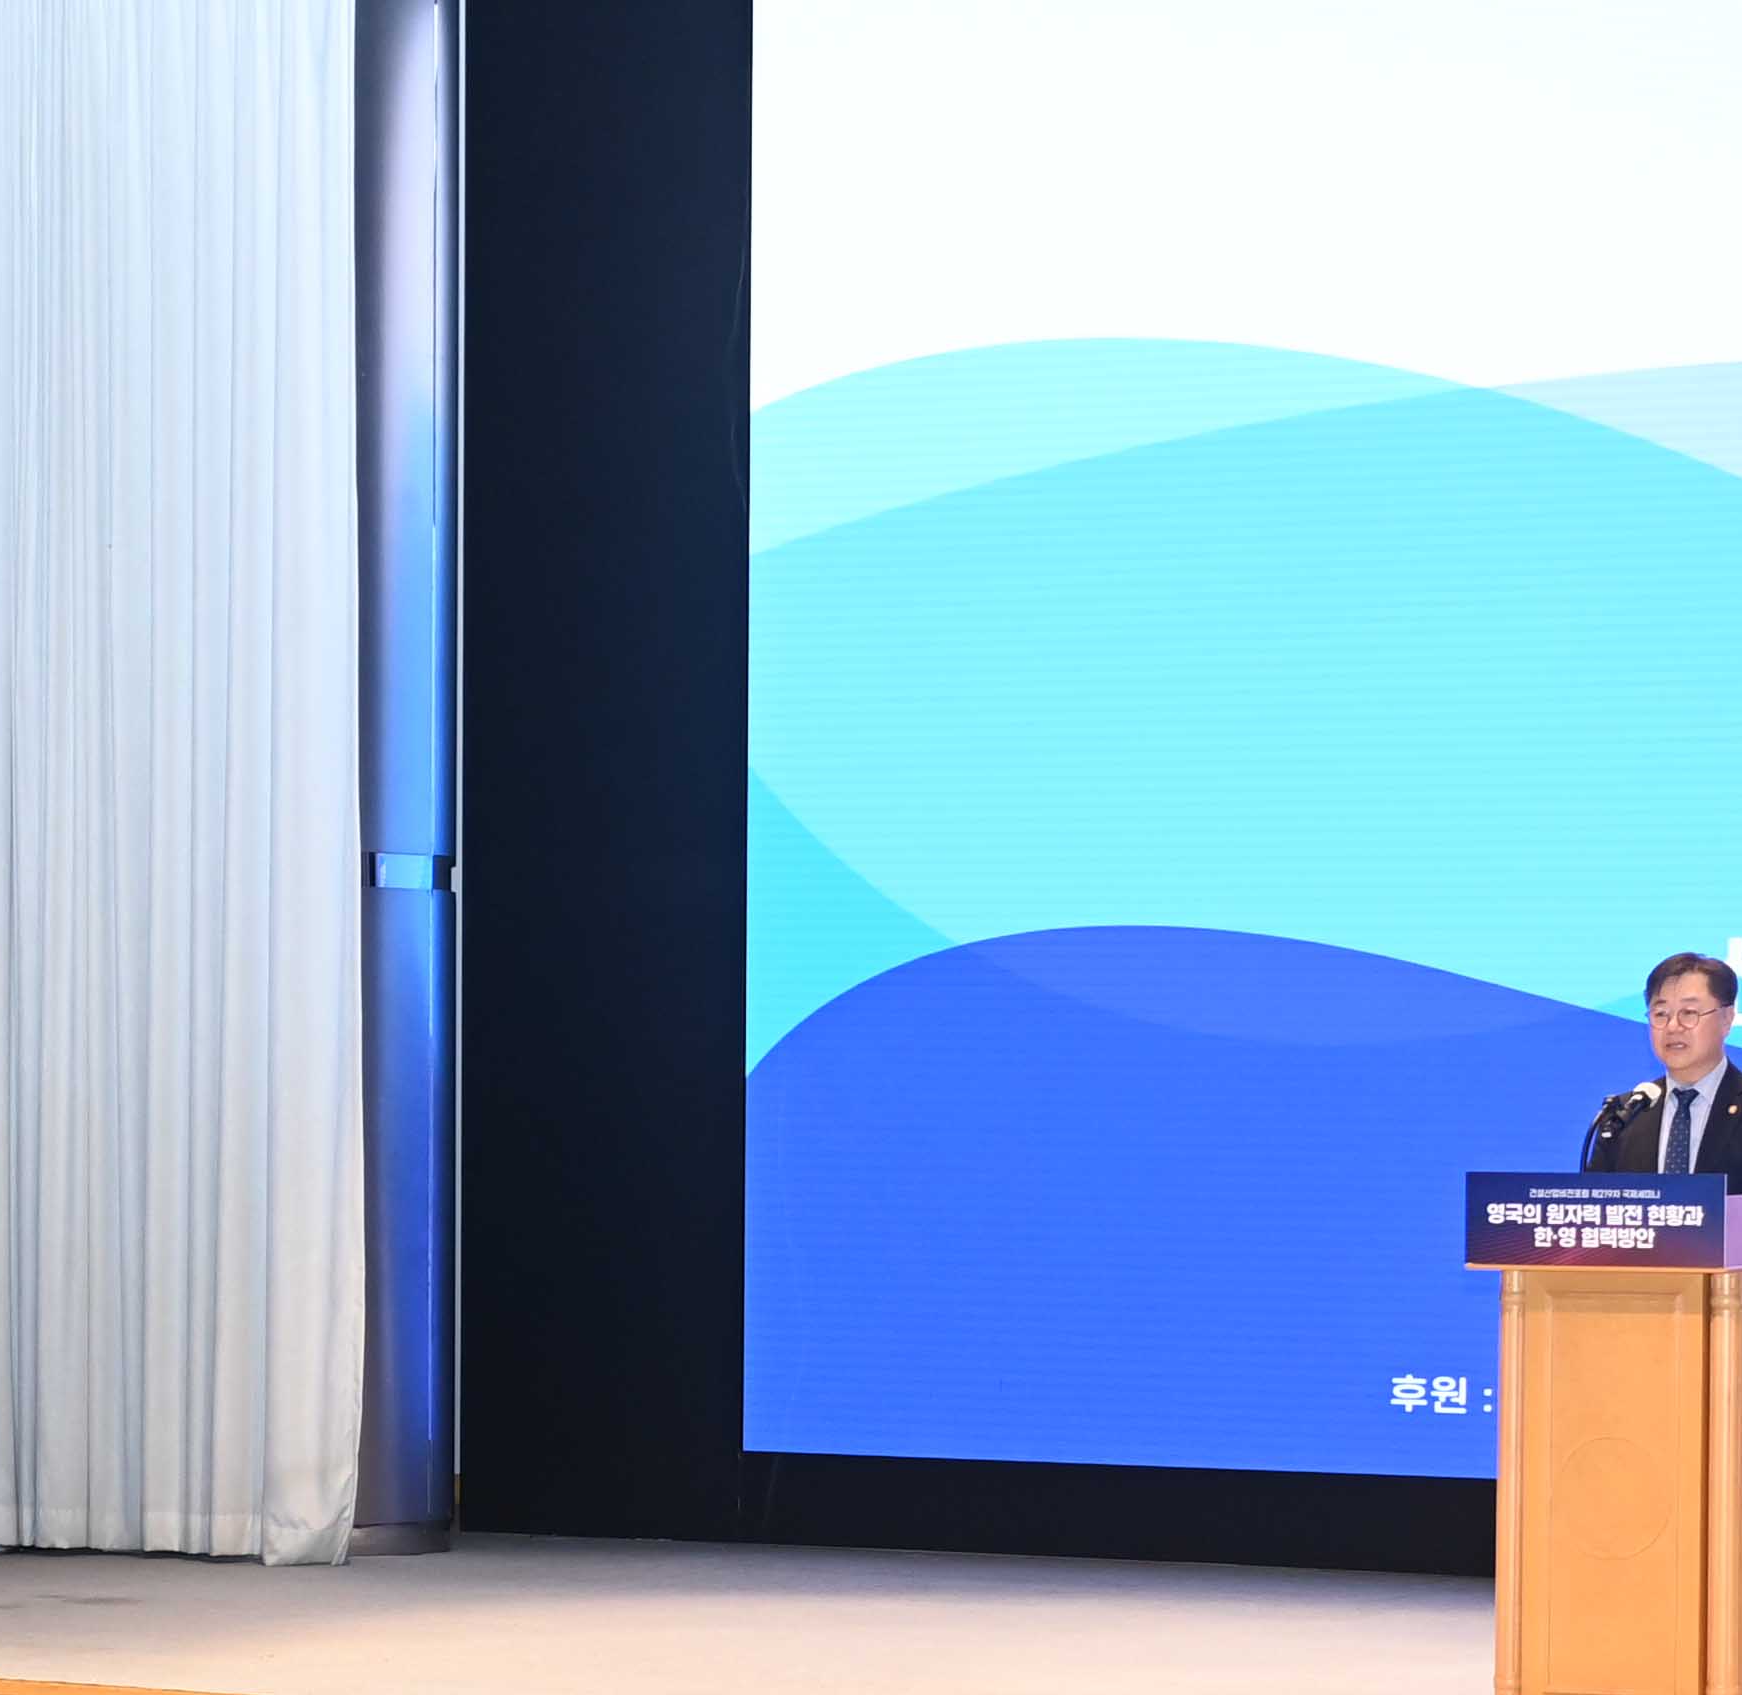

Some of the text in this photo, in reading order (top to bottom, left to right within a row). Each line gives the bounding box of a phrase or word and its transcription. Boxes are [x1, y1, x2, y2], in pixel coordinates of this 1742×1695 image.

[1486, 1203, 1704, 1227] 영국의 원자력 발전 현황과
[1581, 1227, 1655, 1249] 협력방안
[1390, 1373, 1467, 1415] 후원
